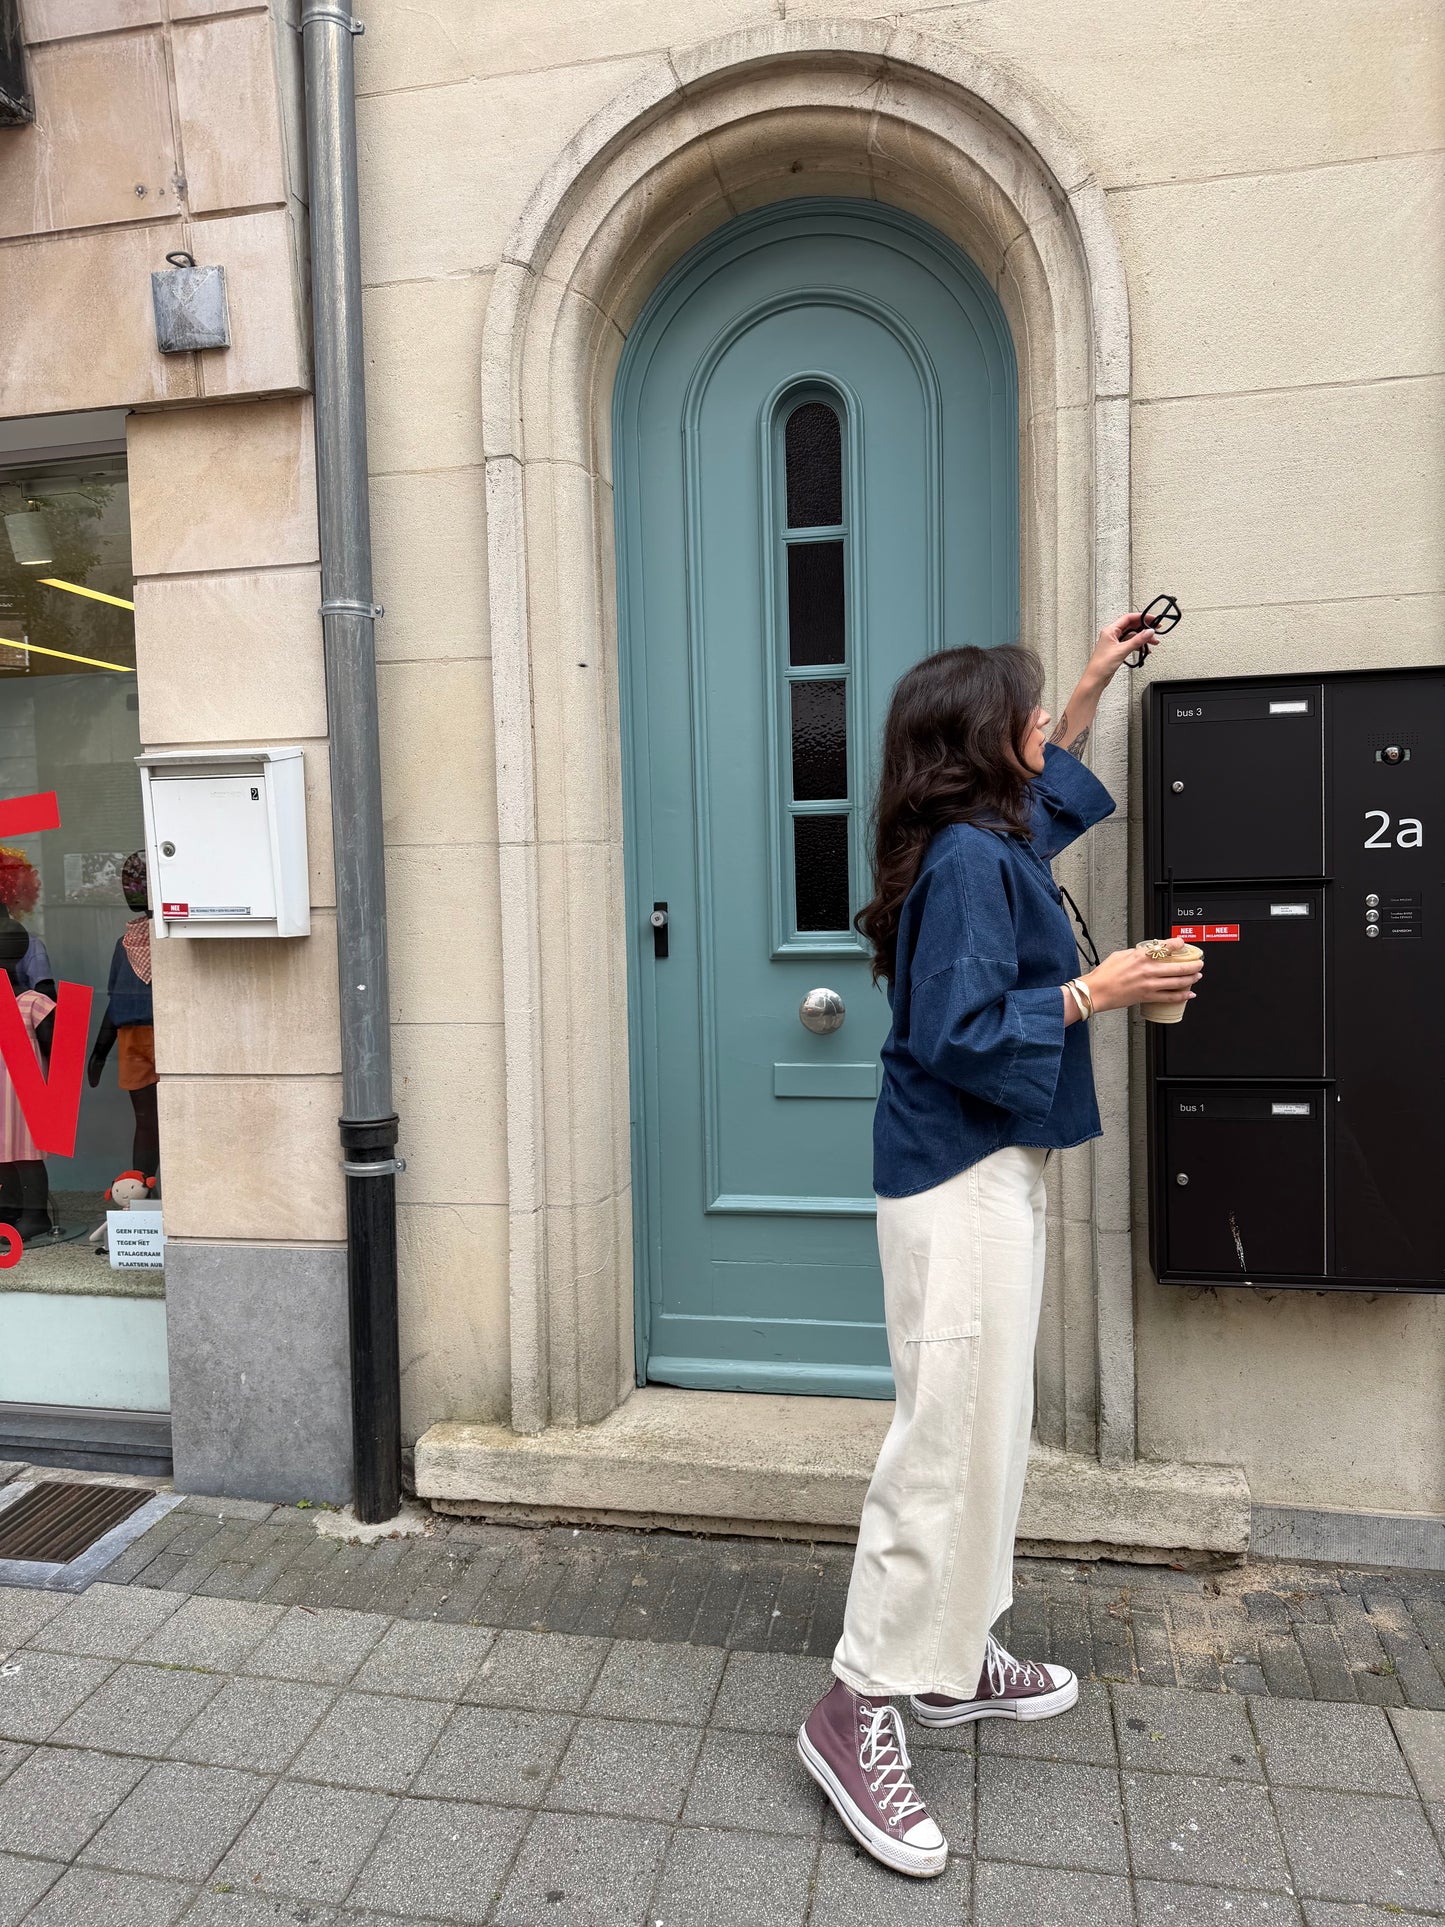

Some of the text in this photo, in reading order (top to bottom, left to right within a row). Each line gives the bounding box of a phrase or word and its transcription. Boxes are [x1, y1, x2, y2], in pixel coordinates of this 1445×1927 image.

[1176, 707, 1202, 717] bus 3
[251, 788, 259, 800] 2
[1364, 810, 1423, 848] 2a
[1177, 907, 1203, 916] bus 2
[1180, 1103, 1204, 1112] bus 1
